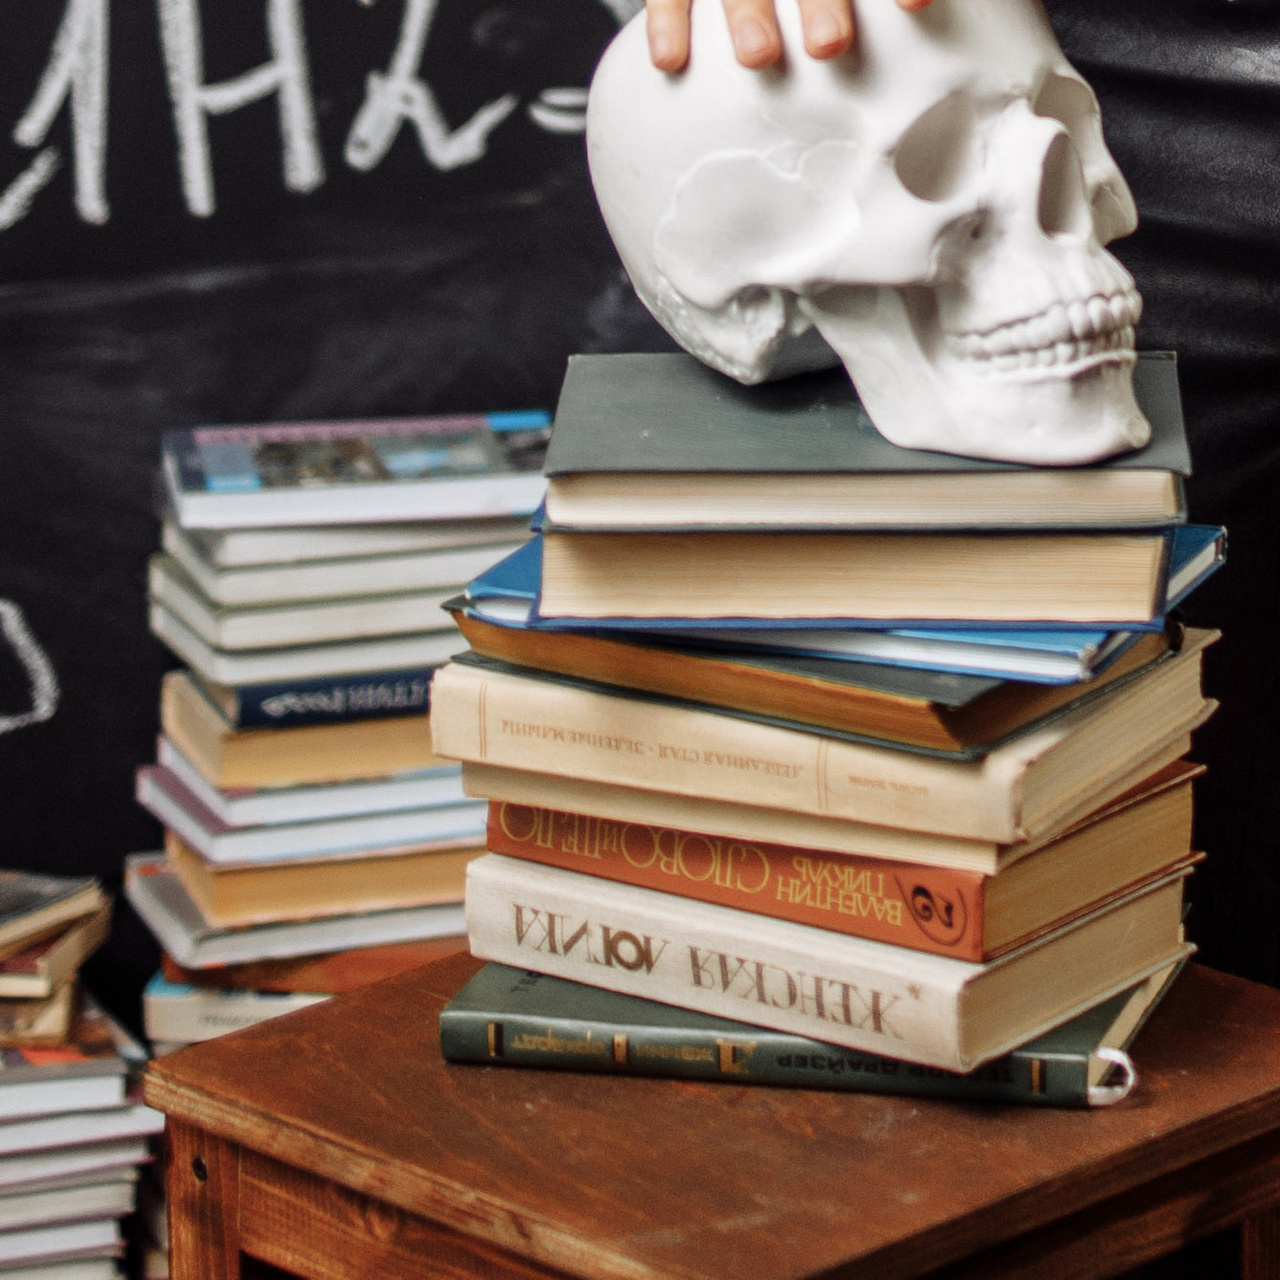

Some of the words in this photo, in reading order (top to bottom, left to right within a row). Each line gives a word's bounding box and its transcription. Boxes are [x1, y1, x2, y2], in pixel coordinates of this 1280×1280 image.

[621, 824, 772, 895] СЛОВО
[794, 853, 885, 898] ПИКУЛЬ
[510, 902, 672, 975] ЛОГИКА
[776, 880, 903, 928] ВАЛЕНТИН
[686, 944, 908, 1041] ЖЕНСКАЯ
